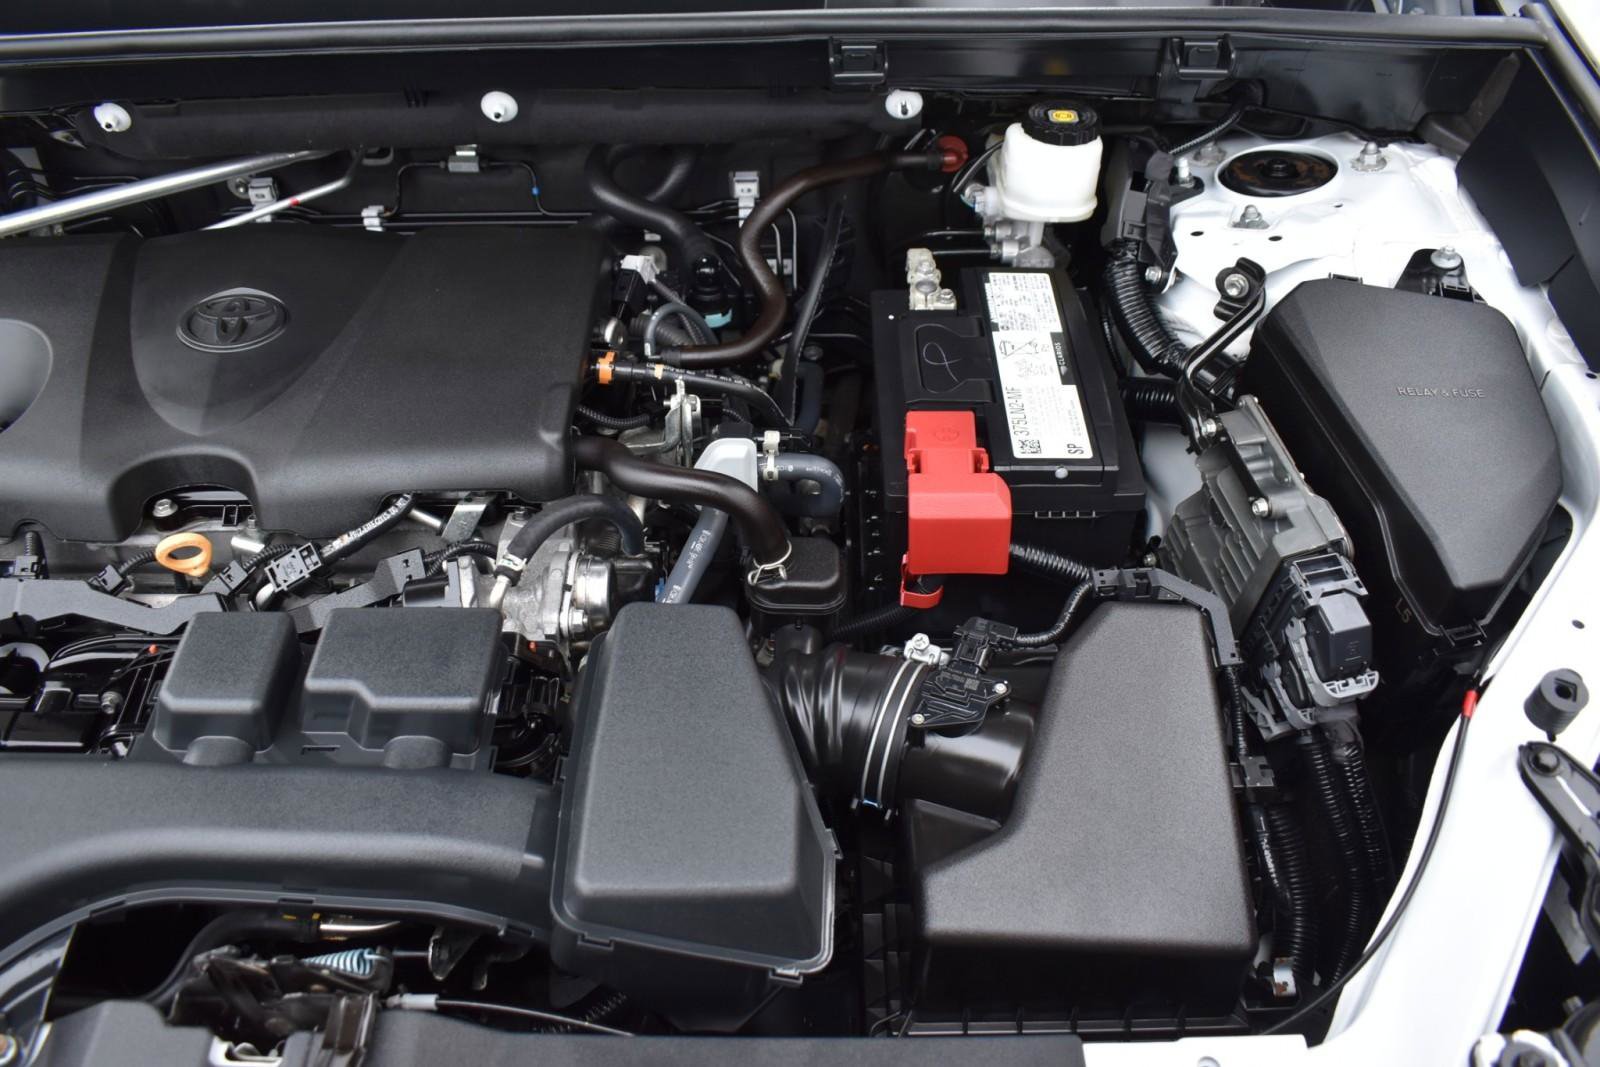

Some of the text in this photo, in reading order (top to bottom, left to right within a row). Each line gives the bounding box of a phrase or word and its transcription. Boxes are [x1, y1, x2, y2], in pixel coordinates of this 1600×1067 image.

[1054, 342, 1066, 366] CLARIOS
[1395, 386, 1486, 398] RELAY & FUSE
[1005, 386, 1030, 436] 375LN2-MF
[1067, 443, 1084, 455] SP
